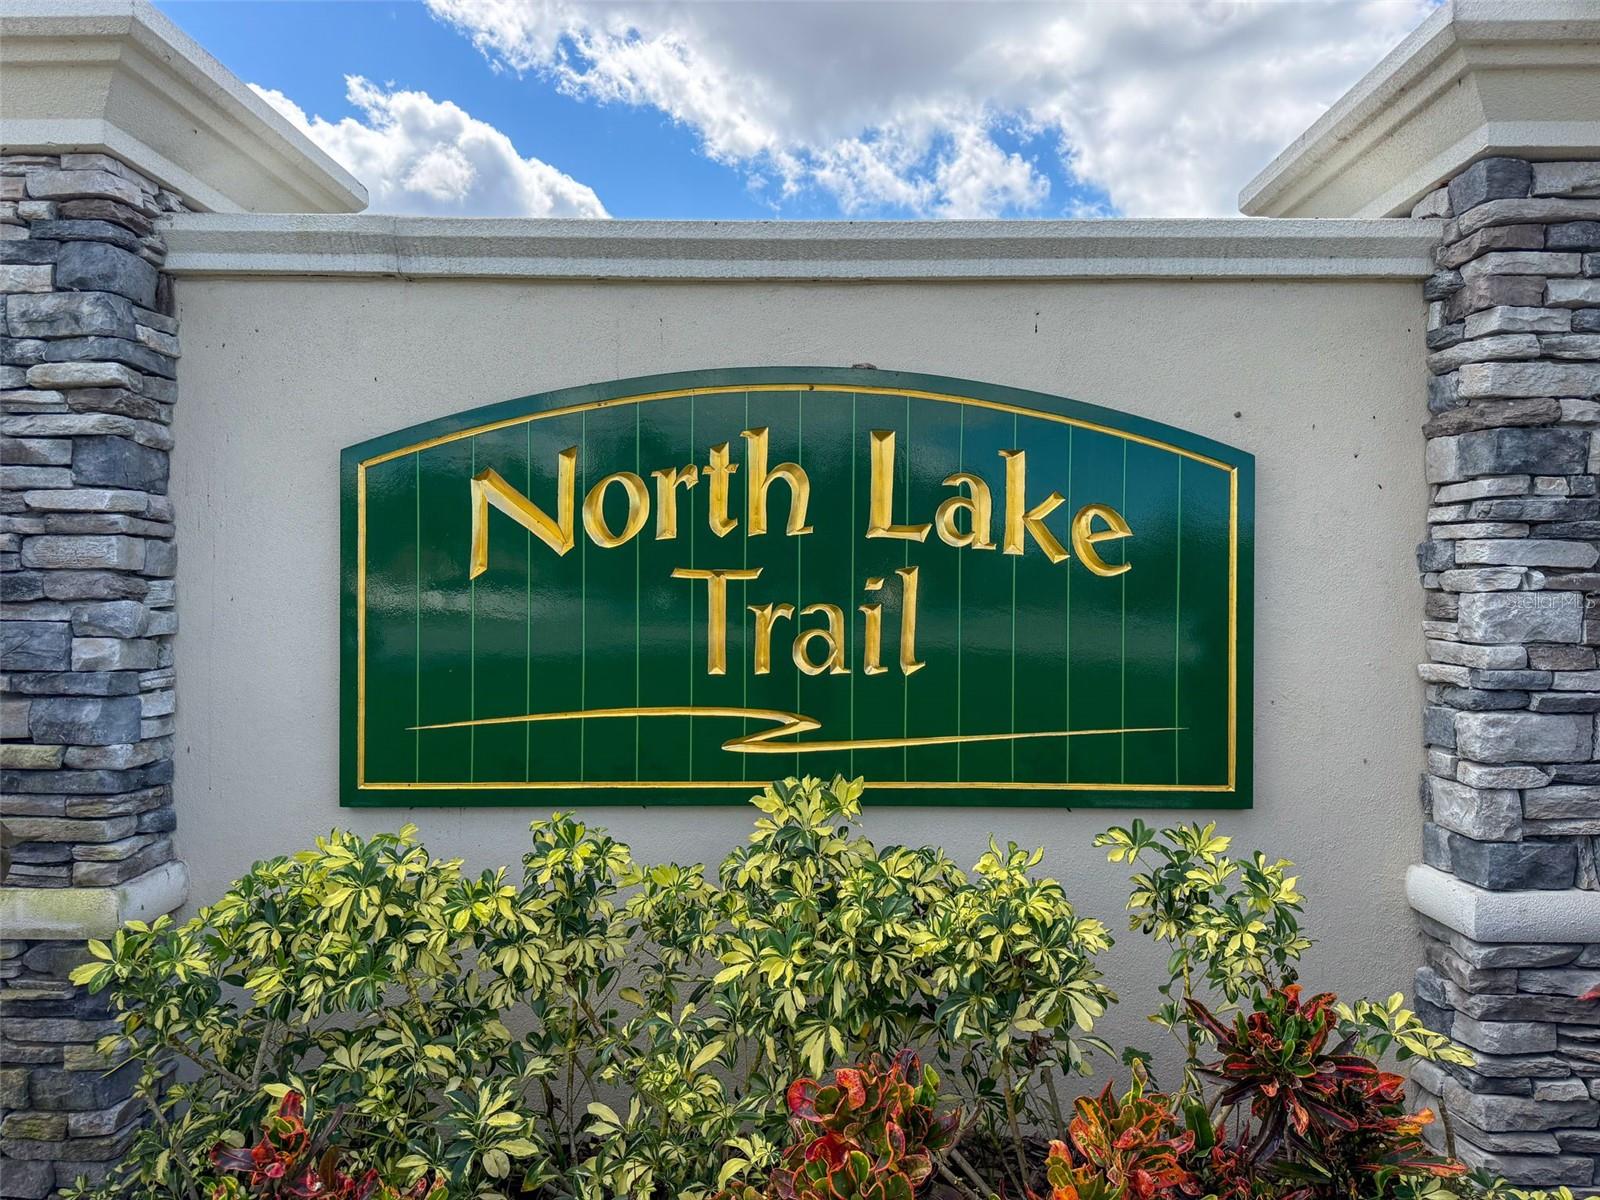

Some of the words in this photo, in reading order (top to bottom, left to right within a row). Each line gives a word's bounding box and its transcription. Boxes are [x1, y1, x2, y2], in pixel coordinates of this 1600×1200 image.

[469, 426, 814, 580] North
[865, 430, 1133, 577] Lake
[671, 566, 926, 676] Trail
